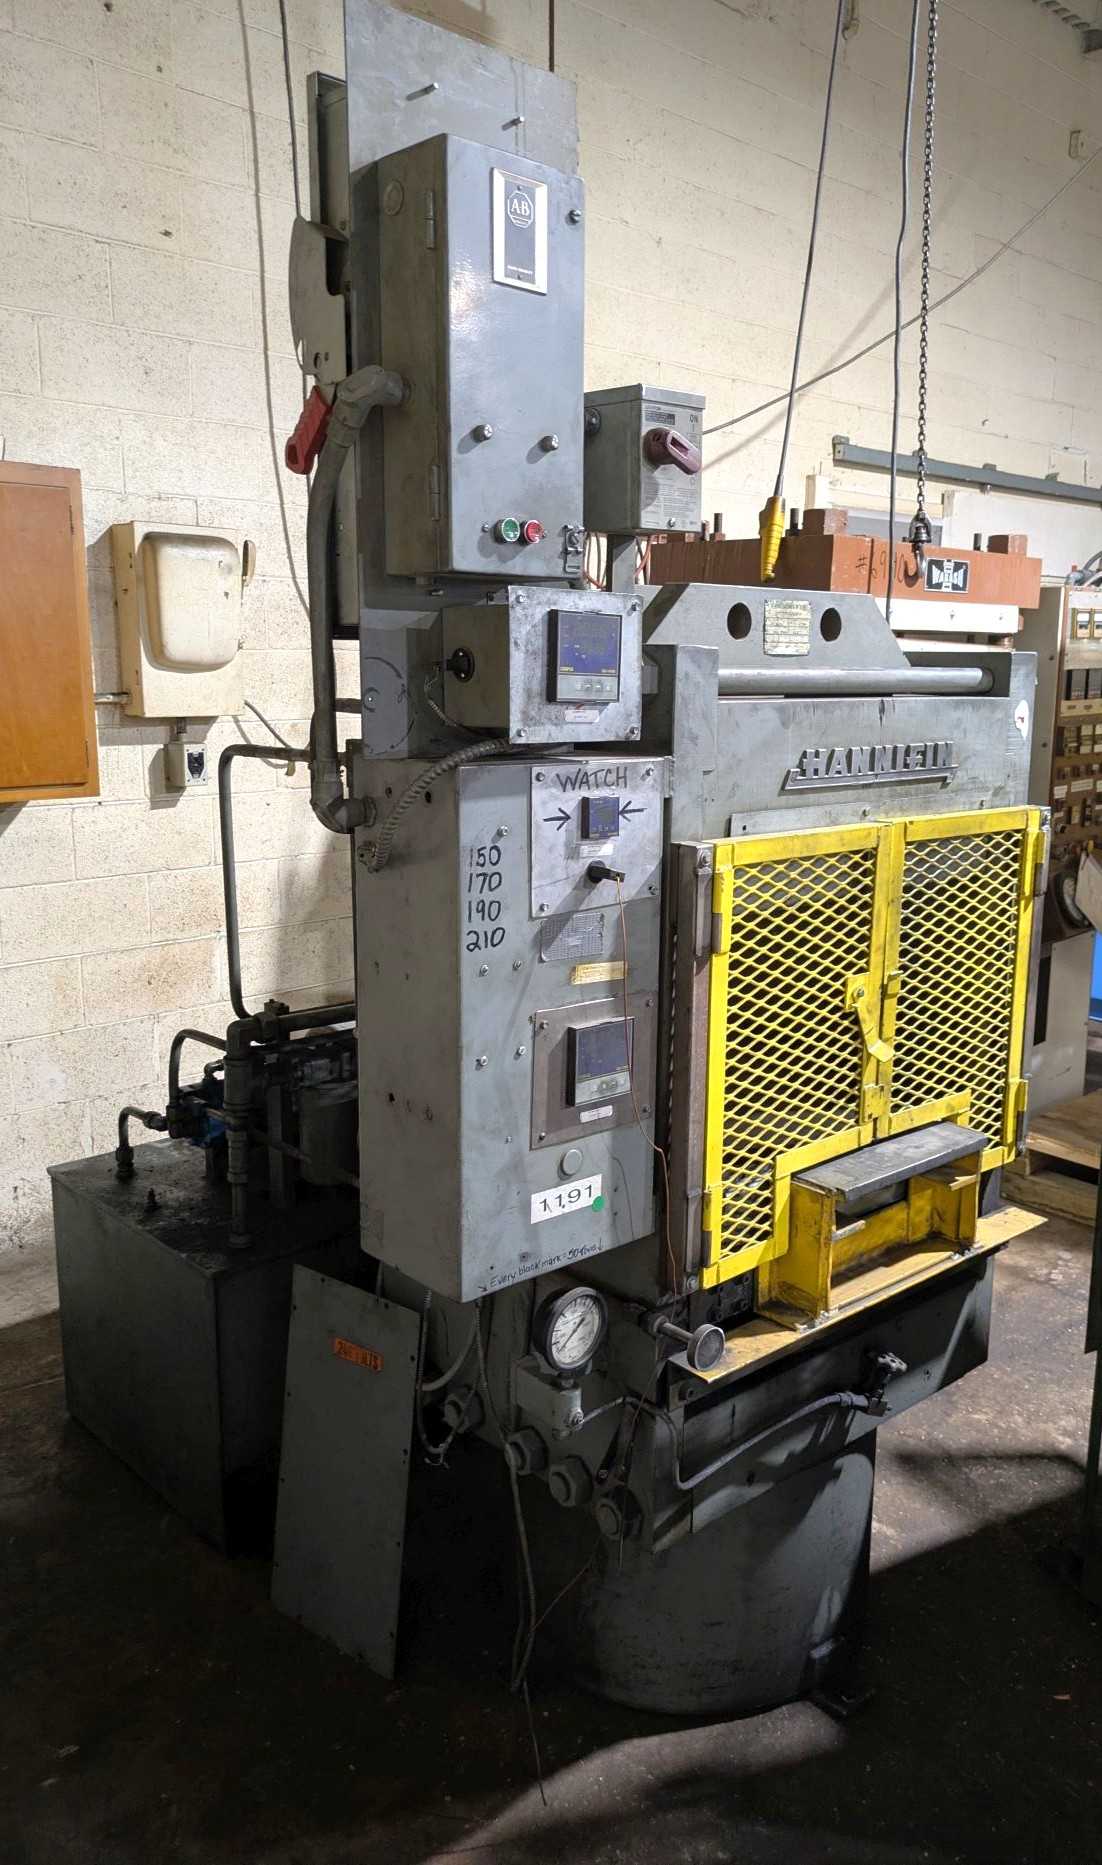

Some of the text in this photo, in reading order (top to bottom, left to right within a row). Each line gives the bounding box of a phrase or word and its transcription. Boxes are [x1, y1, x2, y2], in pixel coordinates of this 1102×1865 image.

[689, 414, 699, 423] ON
[802, 741, 954, 779] HANNIFIN
[556, 766, 627, 792] WATCH
[469, 845, 502, 868] 150
[467, 871, 502, 895] 170
[467, 899, 502, 924] 190
[466, 926, 506, 953] 210
[490, 1271, 517, 1288] Every
[518, 1261, 540, 1276] black
[541, 1255, 562, 1268] mark
